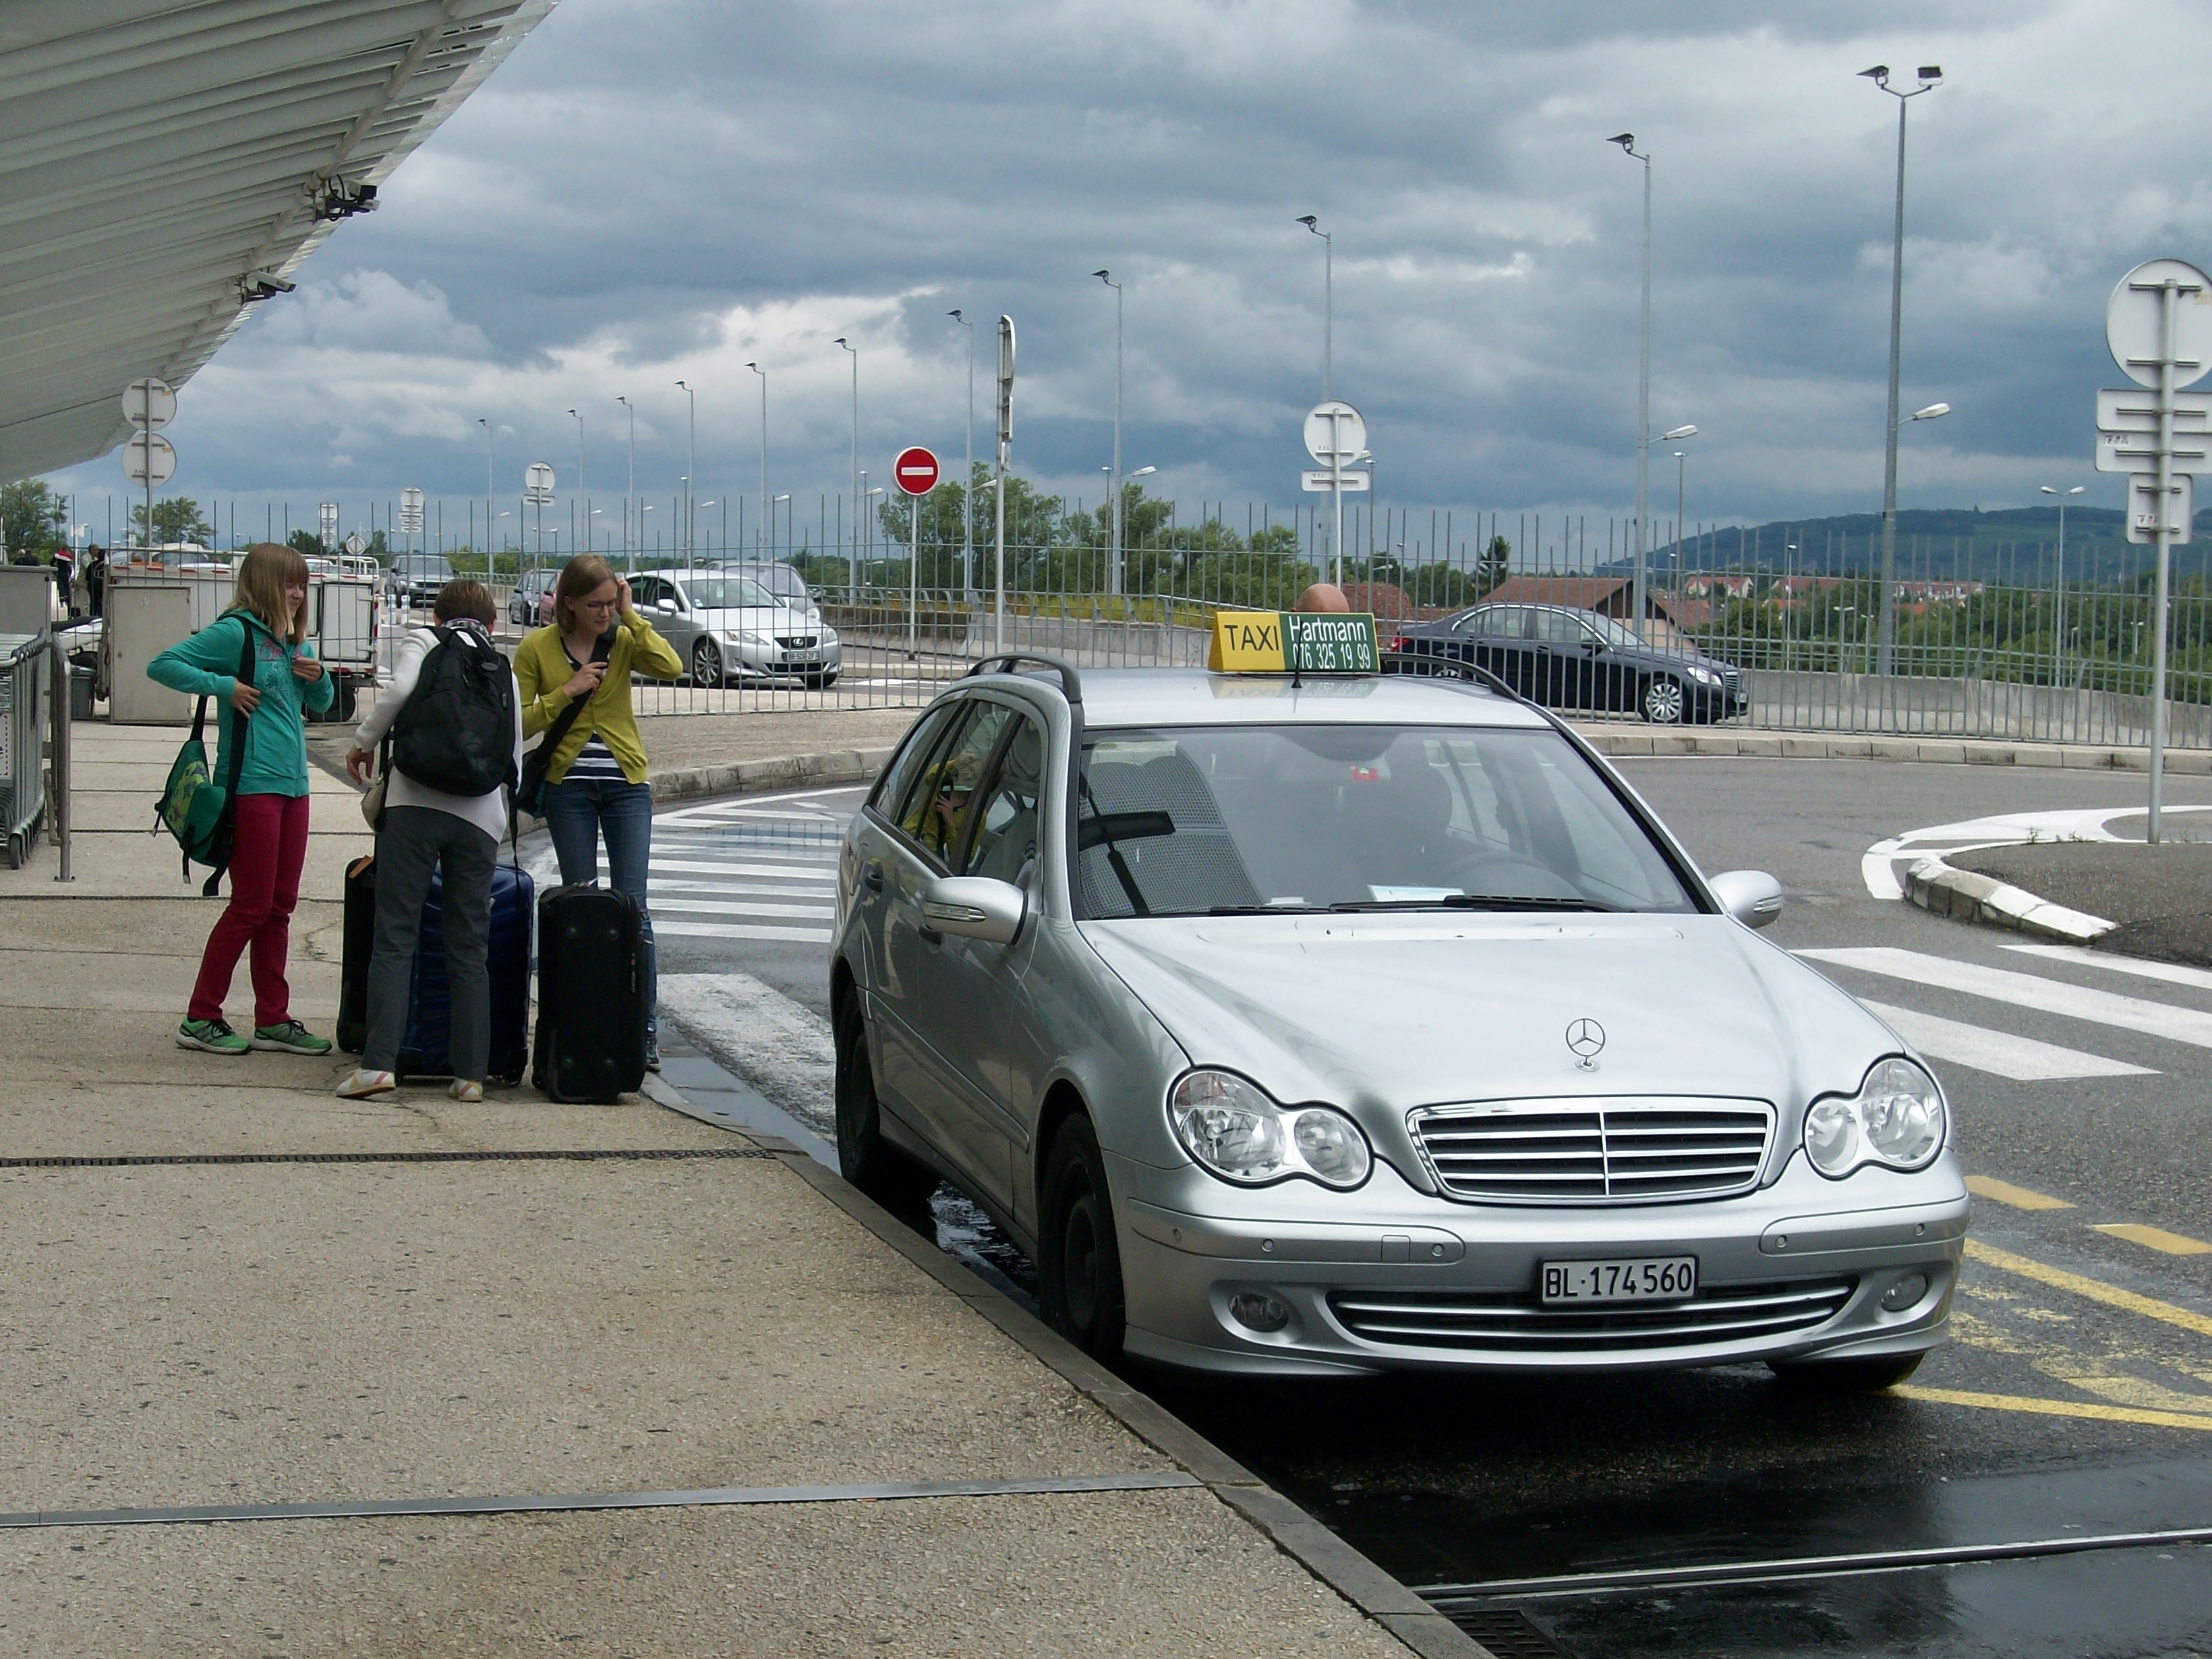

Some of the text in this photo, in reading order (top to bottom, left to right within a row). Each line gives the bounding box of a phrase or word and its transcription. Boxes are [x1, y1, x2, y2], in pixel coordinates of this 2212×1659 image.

[1223, 624, 1279, 651] TAXI
[1289, 615, 1367, 641] Hartmann
[1293, 643, 1371, 669] 076 325 19 99
